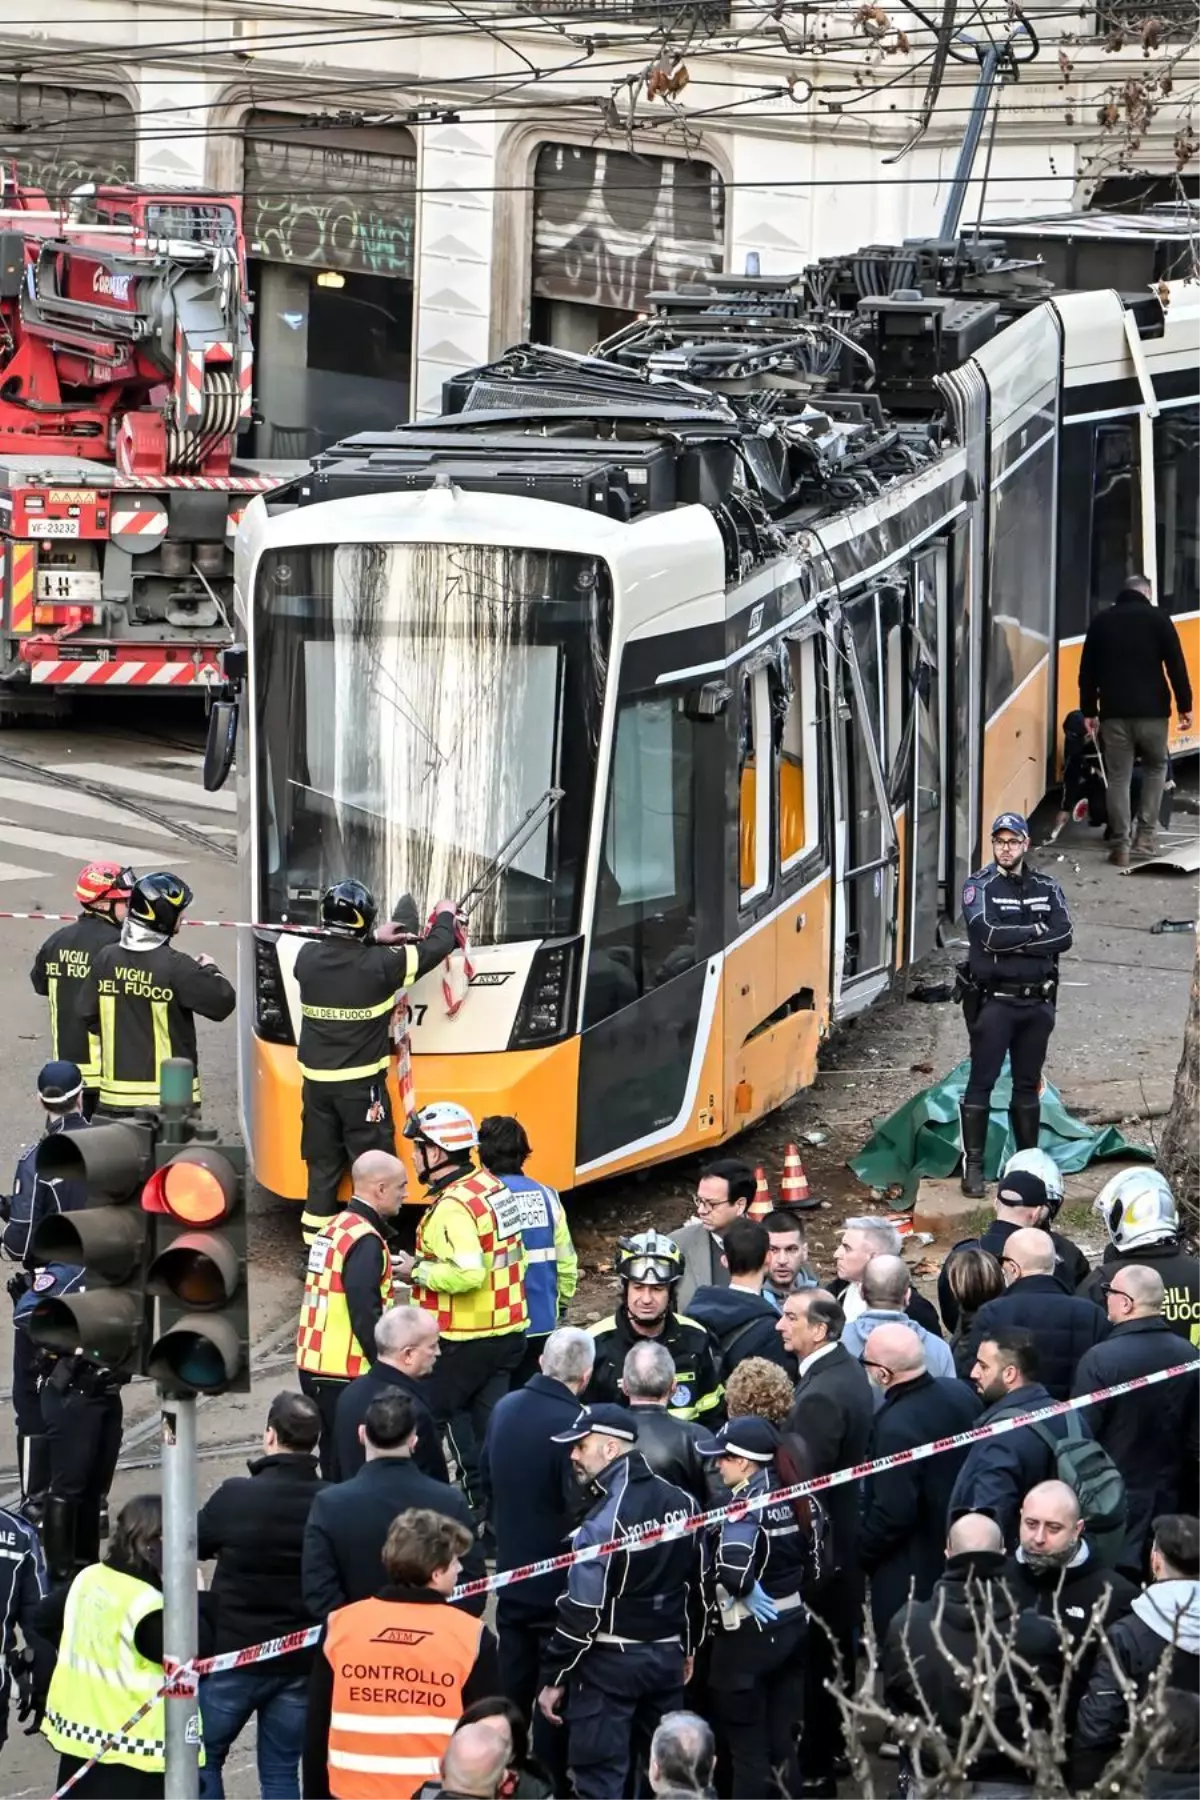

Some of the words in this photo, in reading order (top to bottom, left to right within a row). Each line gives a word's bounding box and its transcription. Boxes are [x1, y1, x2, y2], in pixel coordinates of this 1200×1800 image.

[59, 949, 89, 965] VIGILI
[67, 963, 91, 978] FUO
[115, 966, 153, 985] VIGILI
[125, 981, 173, 1001] FUOCO
[321, 1008, 337, 1018] DEL
[340, 1010, 372, 1020] FUOCO
[388, 1631, 413, 1642] ATM
[341, 1663, 455, 1688] CONTROLLO
[350, 1686, 446, 1708] ESERCIZIO
